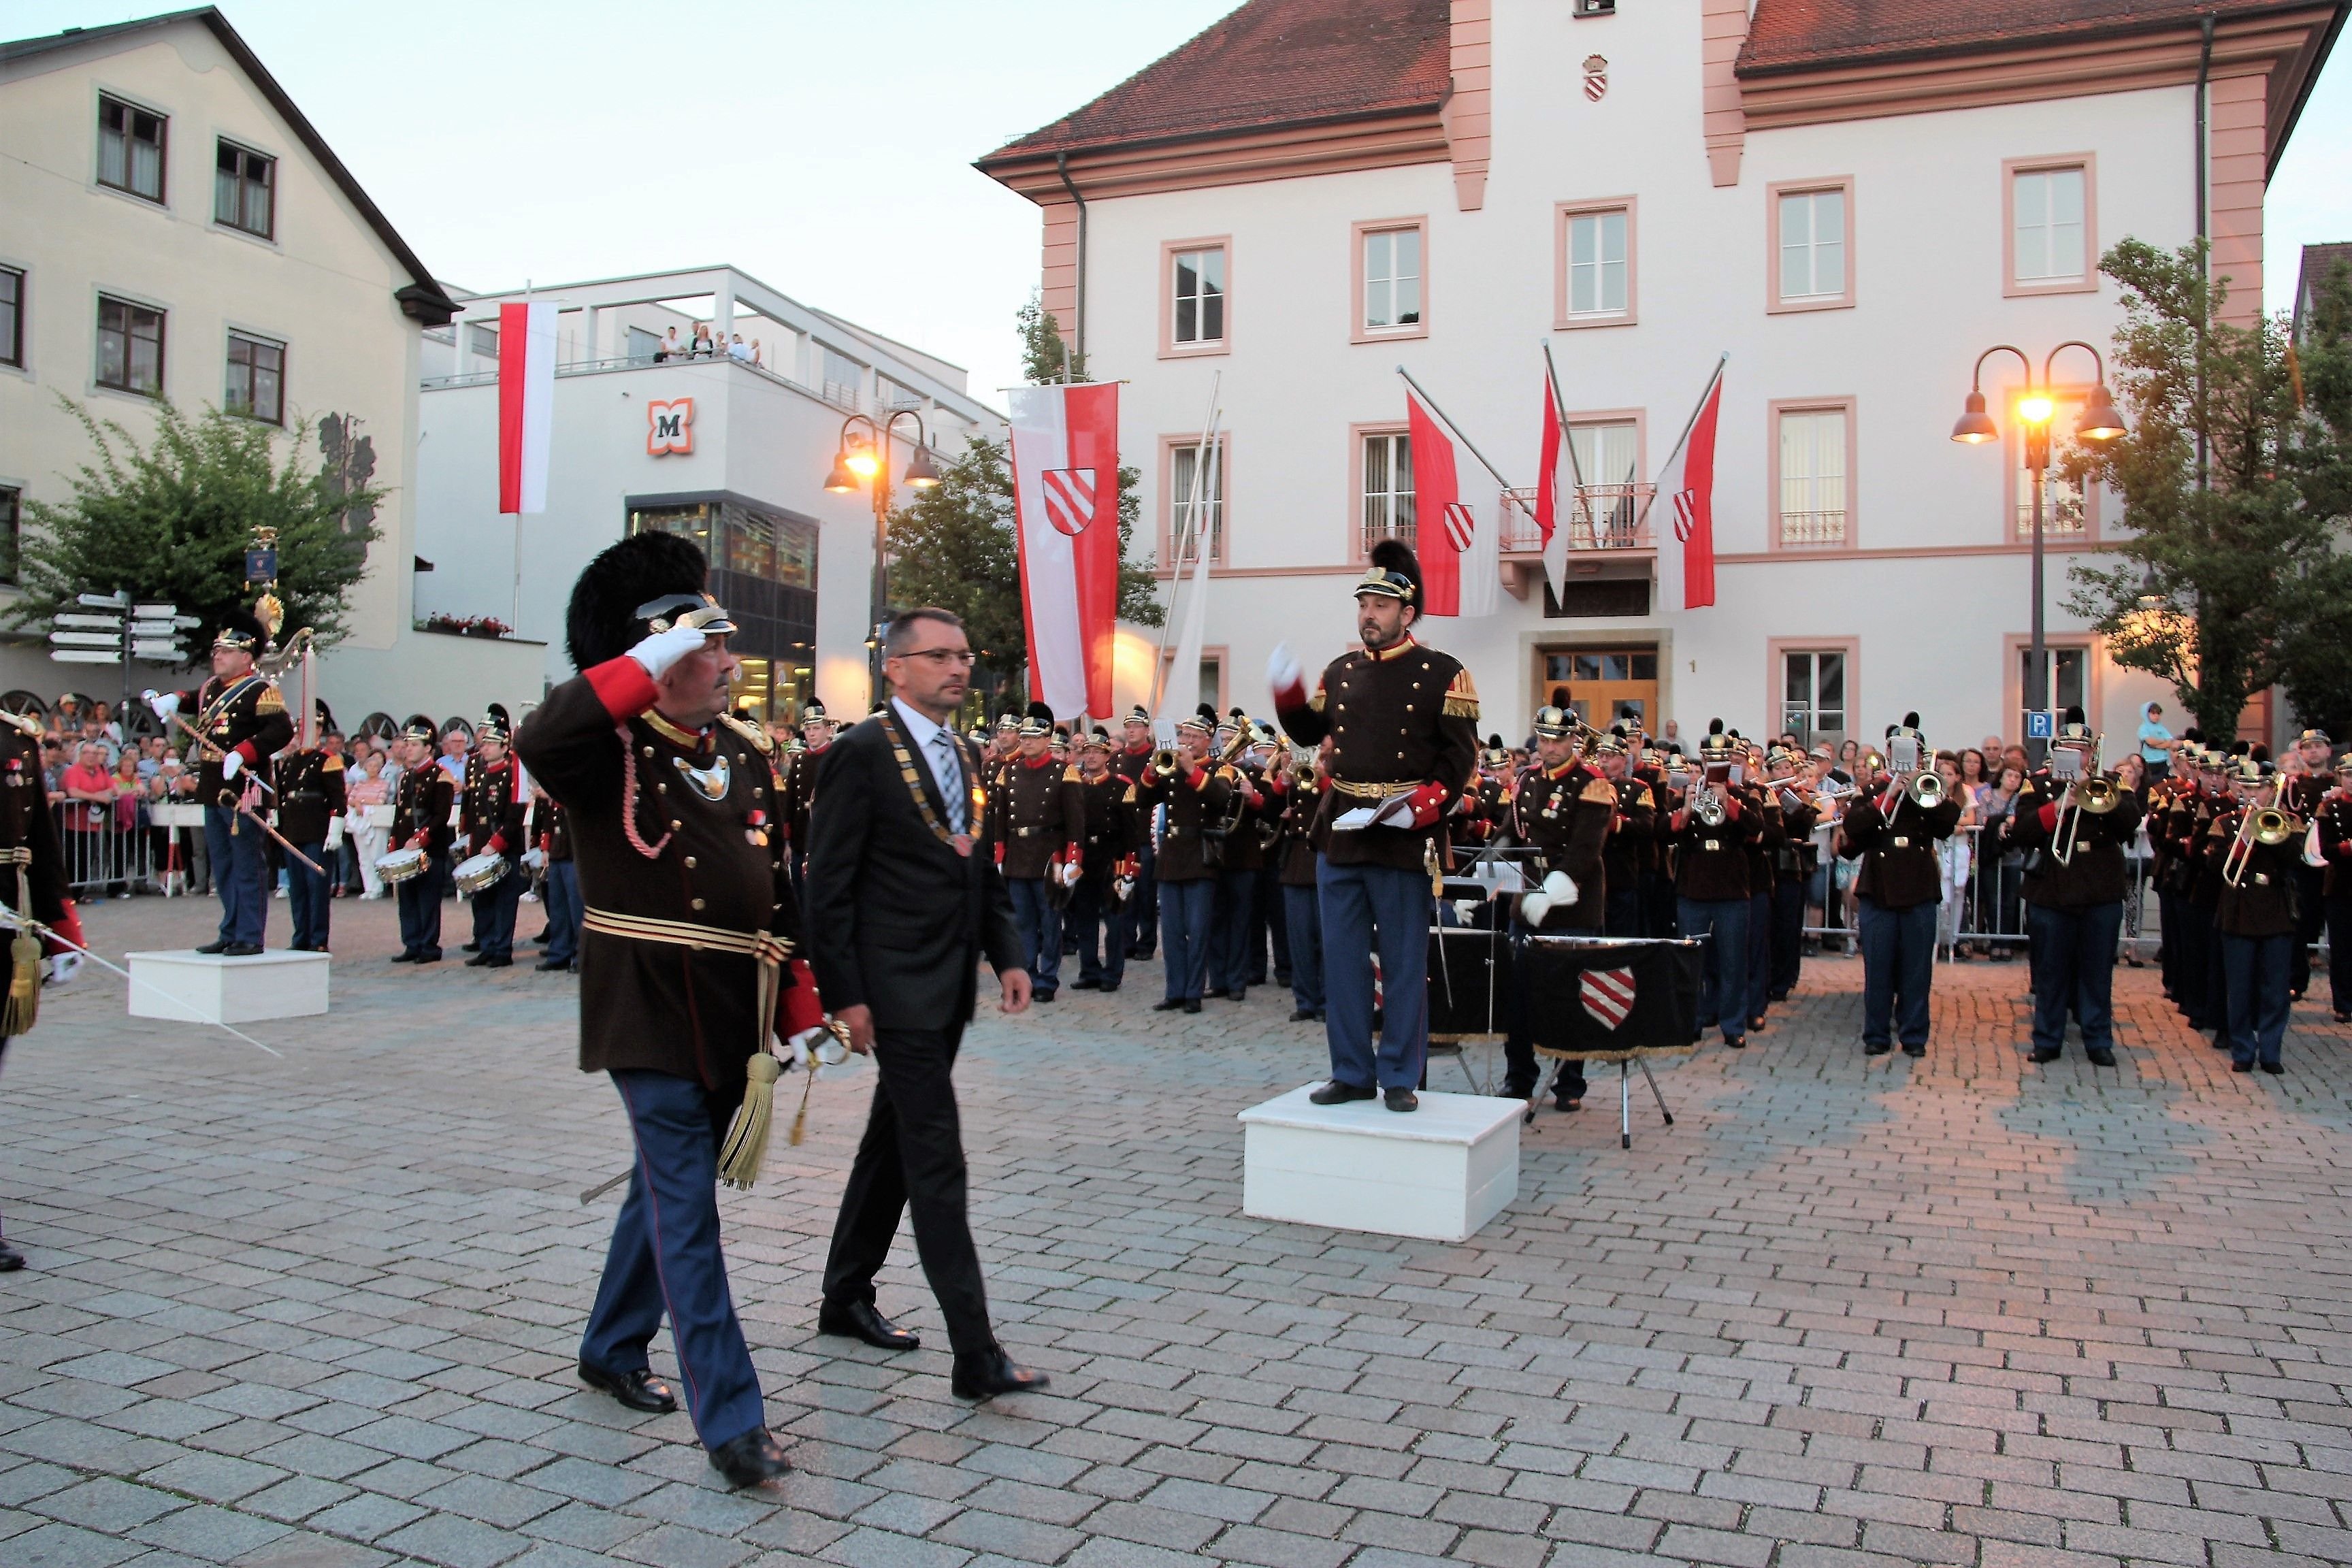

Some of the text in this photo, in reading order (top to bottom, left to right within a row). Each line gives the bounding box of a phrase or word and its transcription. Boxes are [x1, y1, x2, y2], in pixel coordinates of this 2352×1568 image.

[658, 414, 680, 438] M
[1688, 659, 1695, 673] 1
[2034, 715, 2046, 733] P
